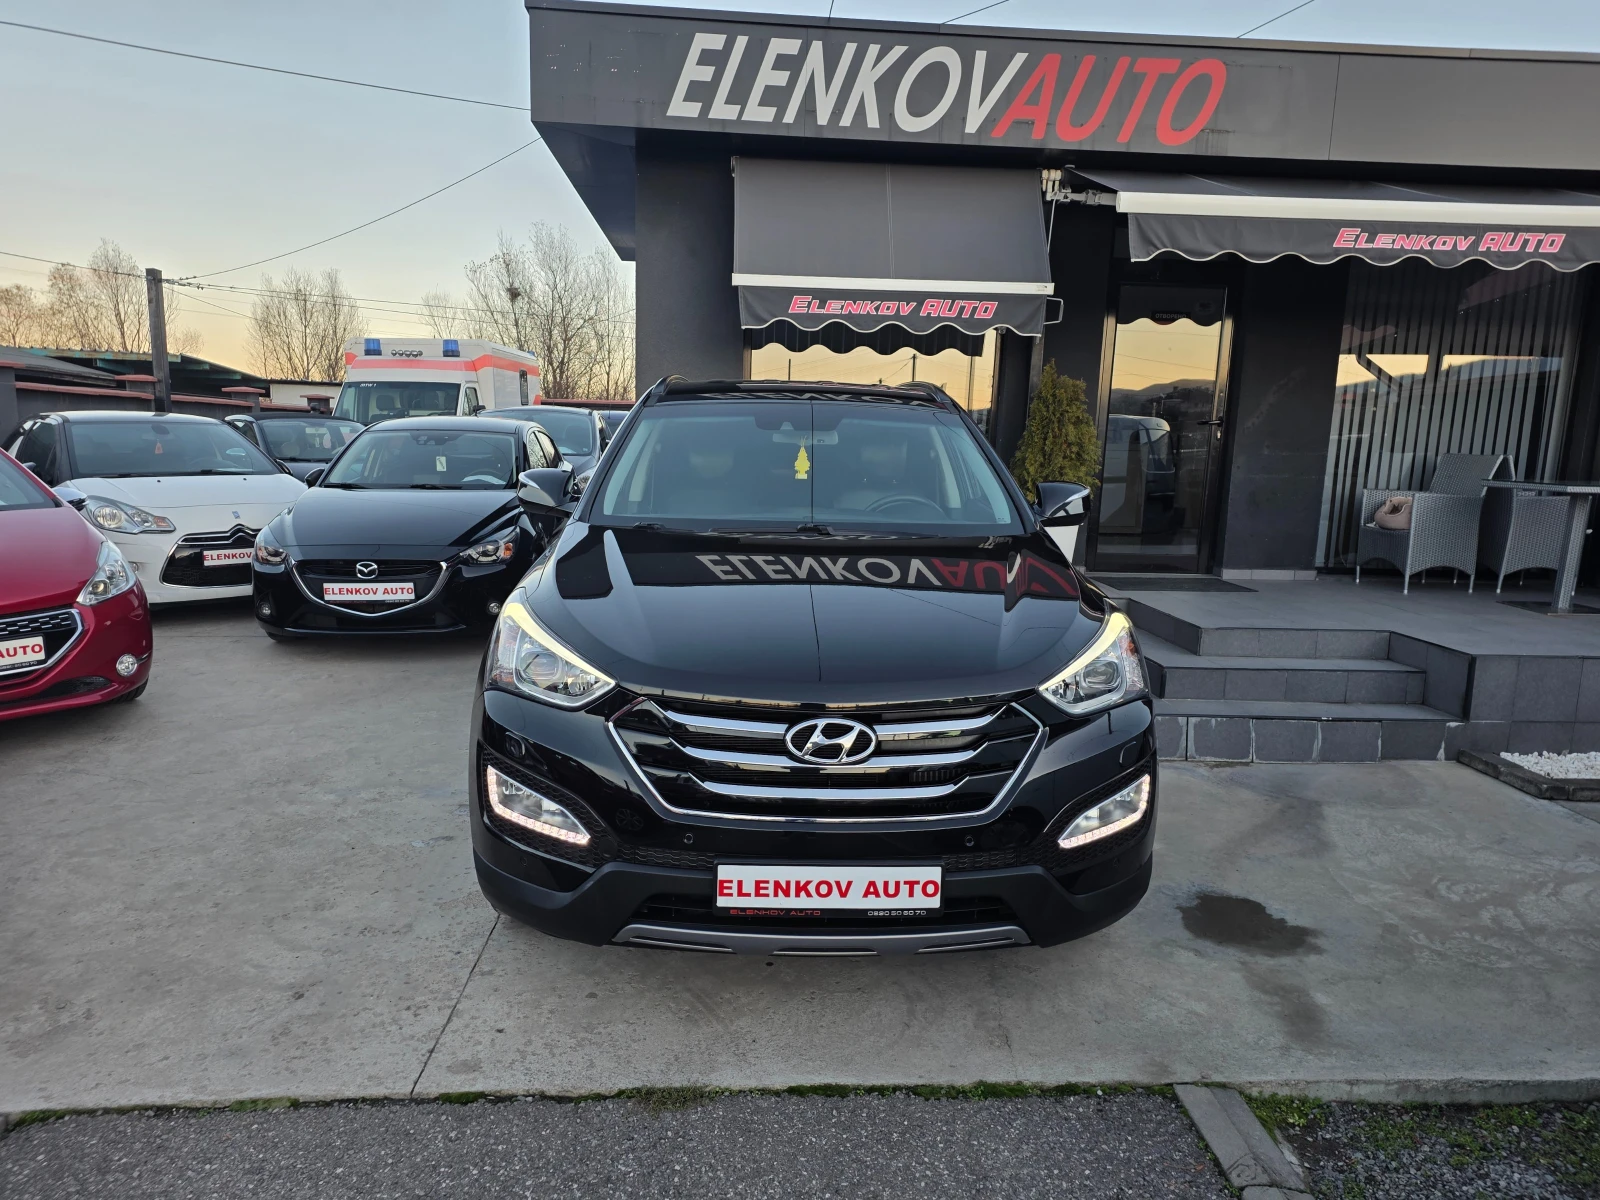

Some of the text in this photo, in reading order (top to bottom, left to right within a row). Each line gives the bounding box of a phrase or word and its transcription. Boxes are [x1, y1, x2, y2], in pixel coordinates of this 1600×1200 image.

[1333, 227, 1567, 253] ELENKOV AUTO
[788, 295, 999, 319] ELENKOV AUTO
[202, 551, 252, 561] ELENKOV
[323, 587, 414, 595] ELENKOV AUTO
[717, 878, 941, 899] ELENKOV AUTO
